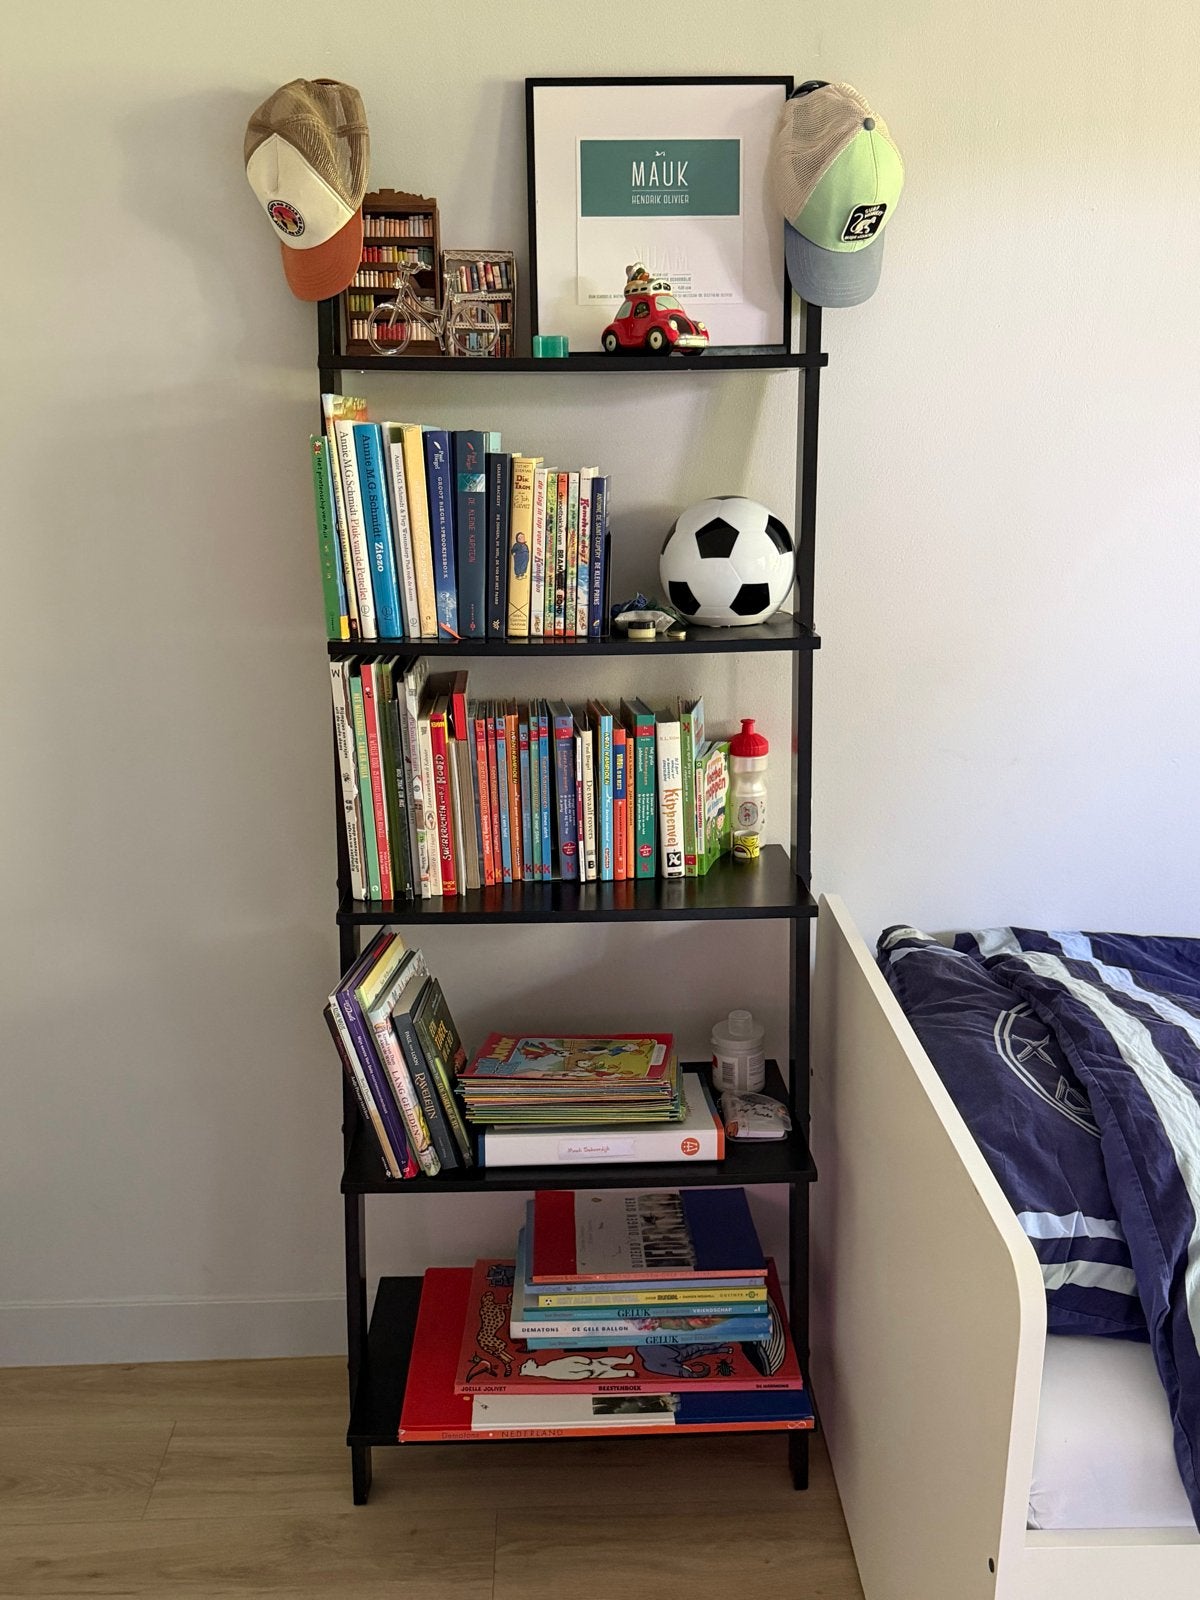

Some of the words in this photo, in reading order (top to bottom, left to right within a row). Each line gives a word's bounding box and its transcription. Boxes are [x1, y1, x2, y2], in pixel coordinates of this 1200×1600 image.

[632, 161, 689, 186] MAUK
[631, 195, 661, 204] HENDRIK
[663, 194, 689, 204] OLIVIER
[340, 431, 349, 457] Annie
[362, 435, 372, 466] Annie
[316, 458, 324, 470] Het
[344, 458, 354, 480] M.G.
[366, 468, 376, 493] M.G.
[516, 474, 529, 482] Dik
[538, 480, 544, 489] de
[316, 471, 326, 510] piratenschip
[346, 480, 357, 516] Schmidt
[536, 492, 544, 506] vlag
[370, 494, 382, 538] Schmidt
[398, 486, 406, 508] Schmidt
[402, 528, 410, 558] Westendorp
[468, 509, 476, 530] KLEINE
[536, 517, 544, 528] top
[538, 508, 544, 516] in
[350, 519, 360, 538] Pluk
[374, 542, 384, 572] Ziezo
[468, 534, 476, 562] KAPITEIN
[536, 548, 542, 556] de
[356, 556, 364, 566] de
[356, 568, 368, 601] Petteflet
[535, 556, 544, 592] Kameleon
[436, 754, 446, 784] HOOFD
[586, 780, 592, 792] De
[662, 788, 682, 848] Kippenvel
[404, 1031, 412, 1043] PAUL
[410, 1051, 419, 1065] LOON
[392, 1070, 406, 1094] LANG
[413, 1071, 439, 1120] RAVELEIJN
[617, 1308, 650, 1318] GELUK
[646, 1335, 679, 1344] GELUK
[501, 1430, 563, 1438] NEDERLAND
